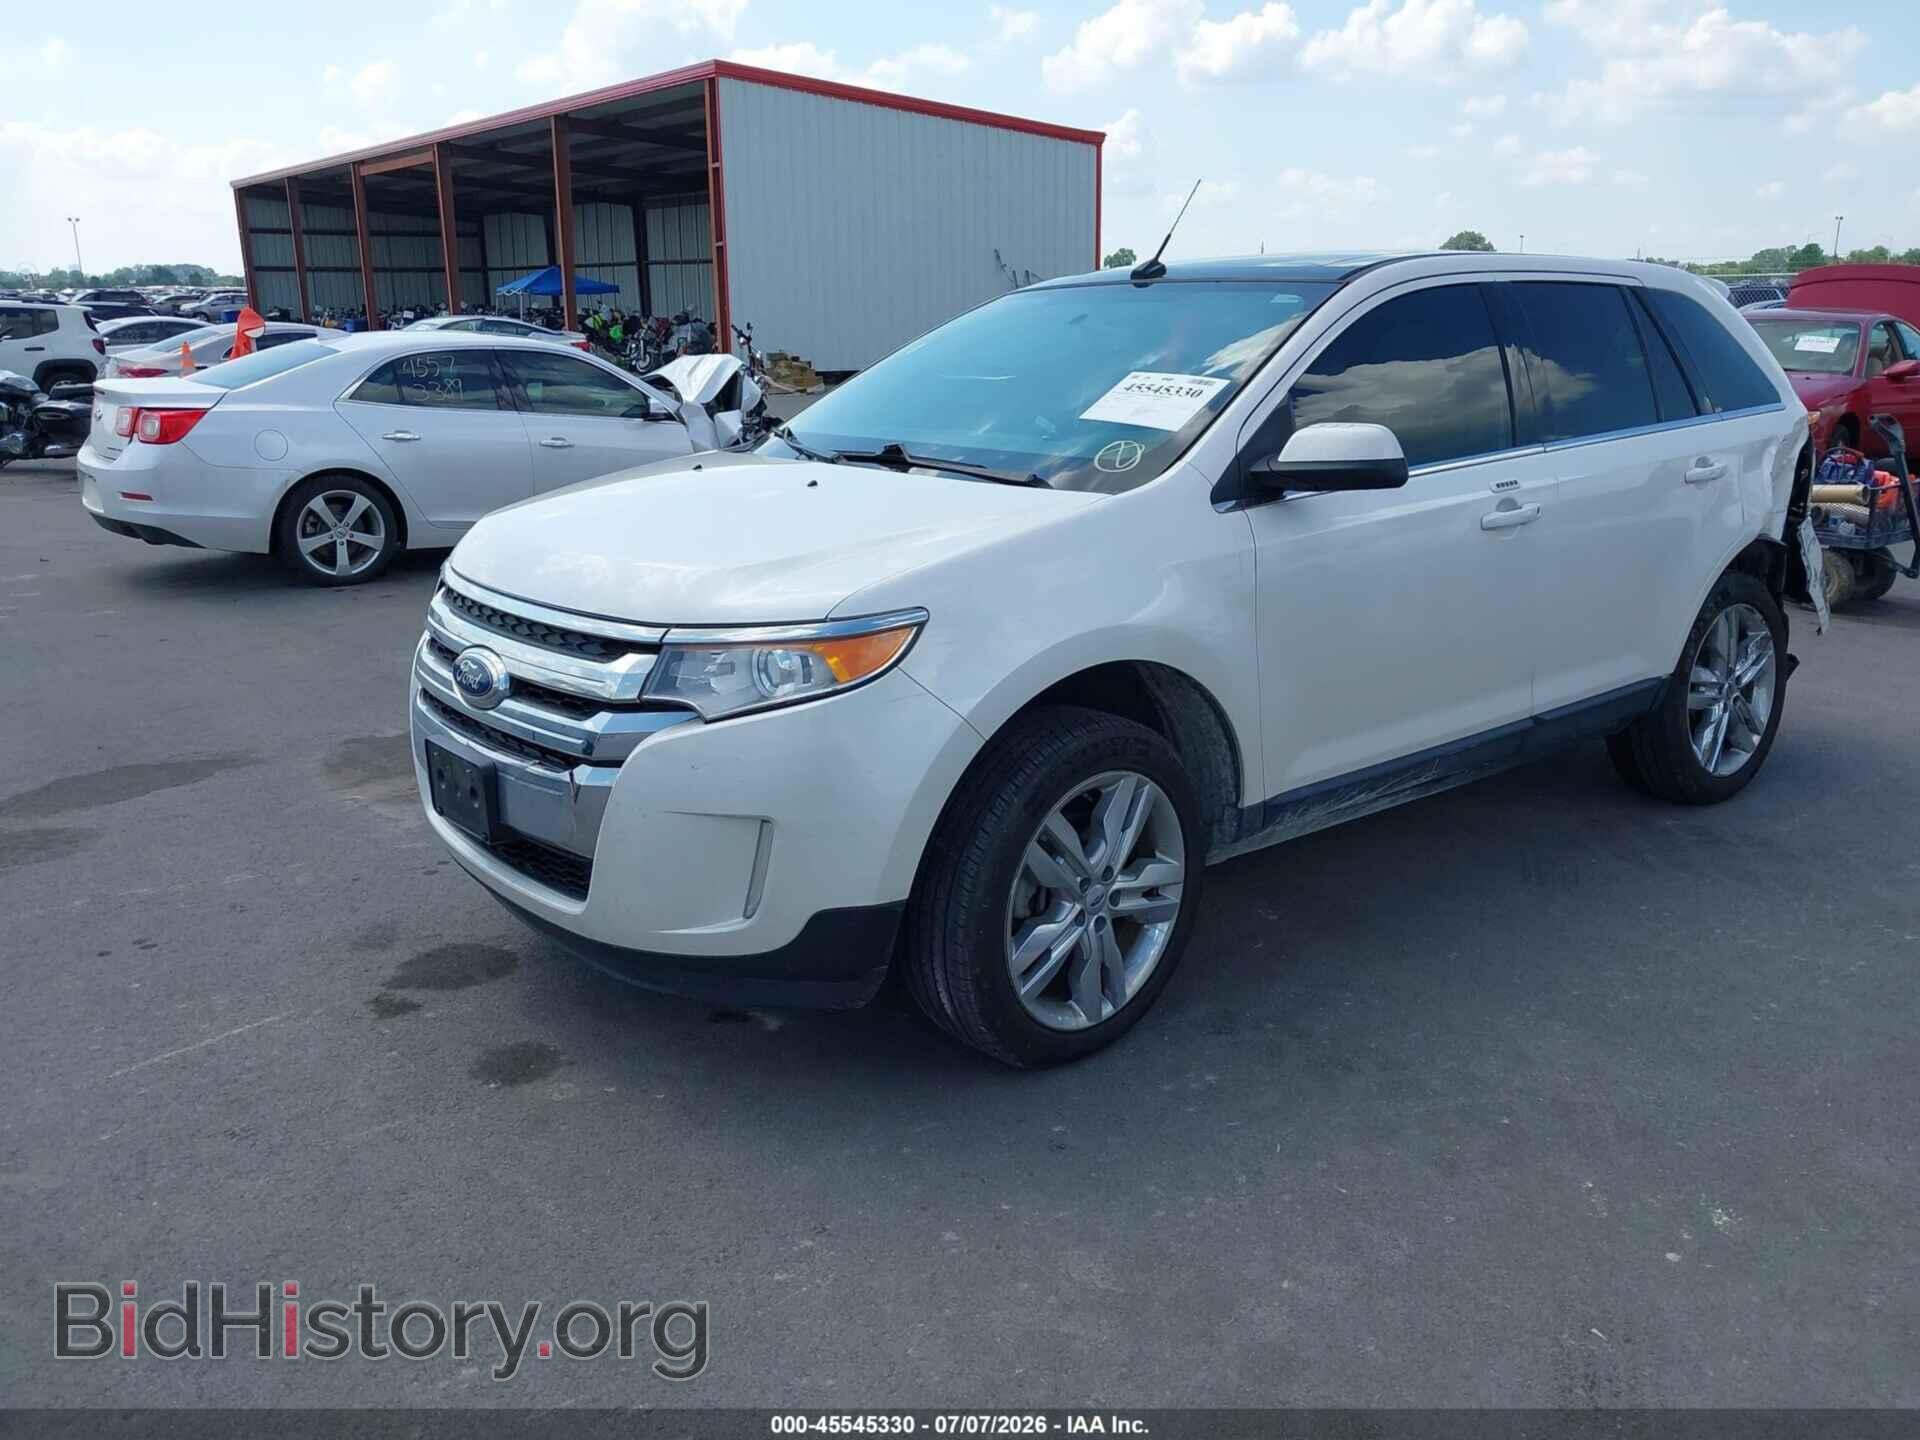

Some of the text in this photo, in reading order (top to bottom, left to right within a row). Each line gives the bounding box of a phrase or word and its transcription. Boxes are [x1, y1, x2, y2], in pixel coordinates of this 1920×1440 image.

[402, 355, 456, 378] 4557
[1123, 383, 1204, 399] 45545330
[456, 660, 482, 690] Ford
